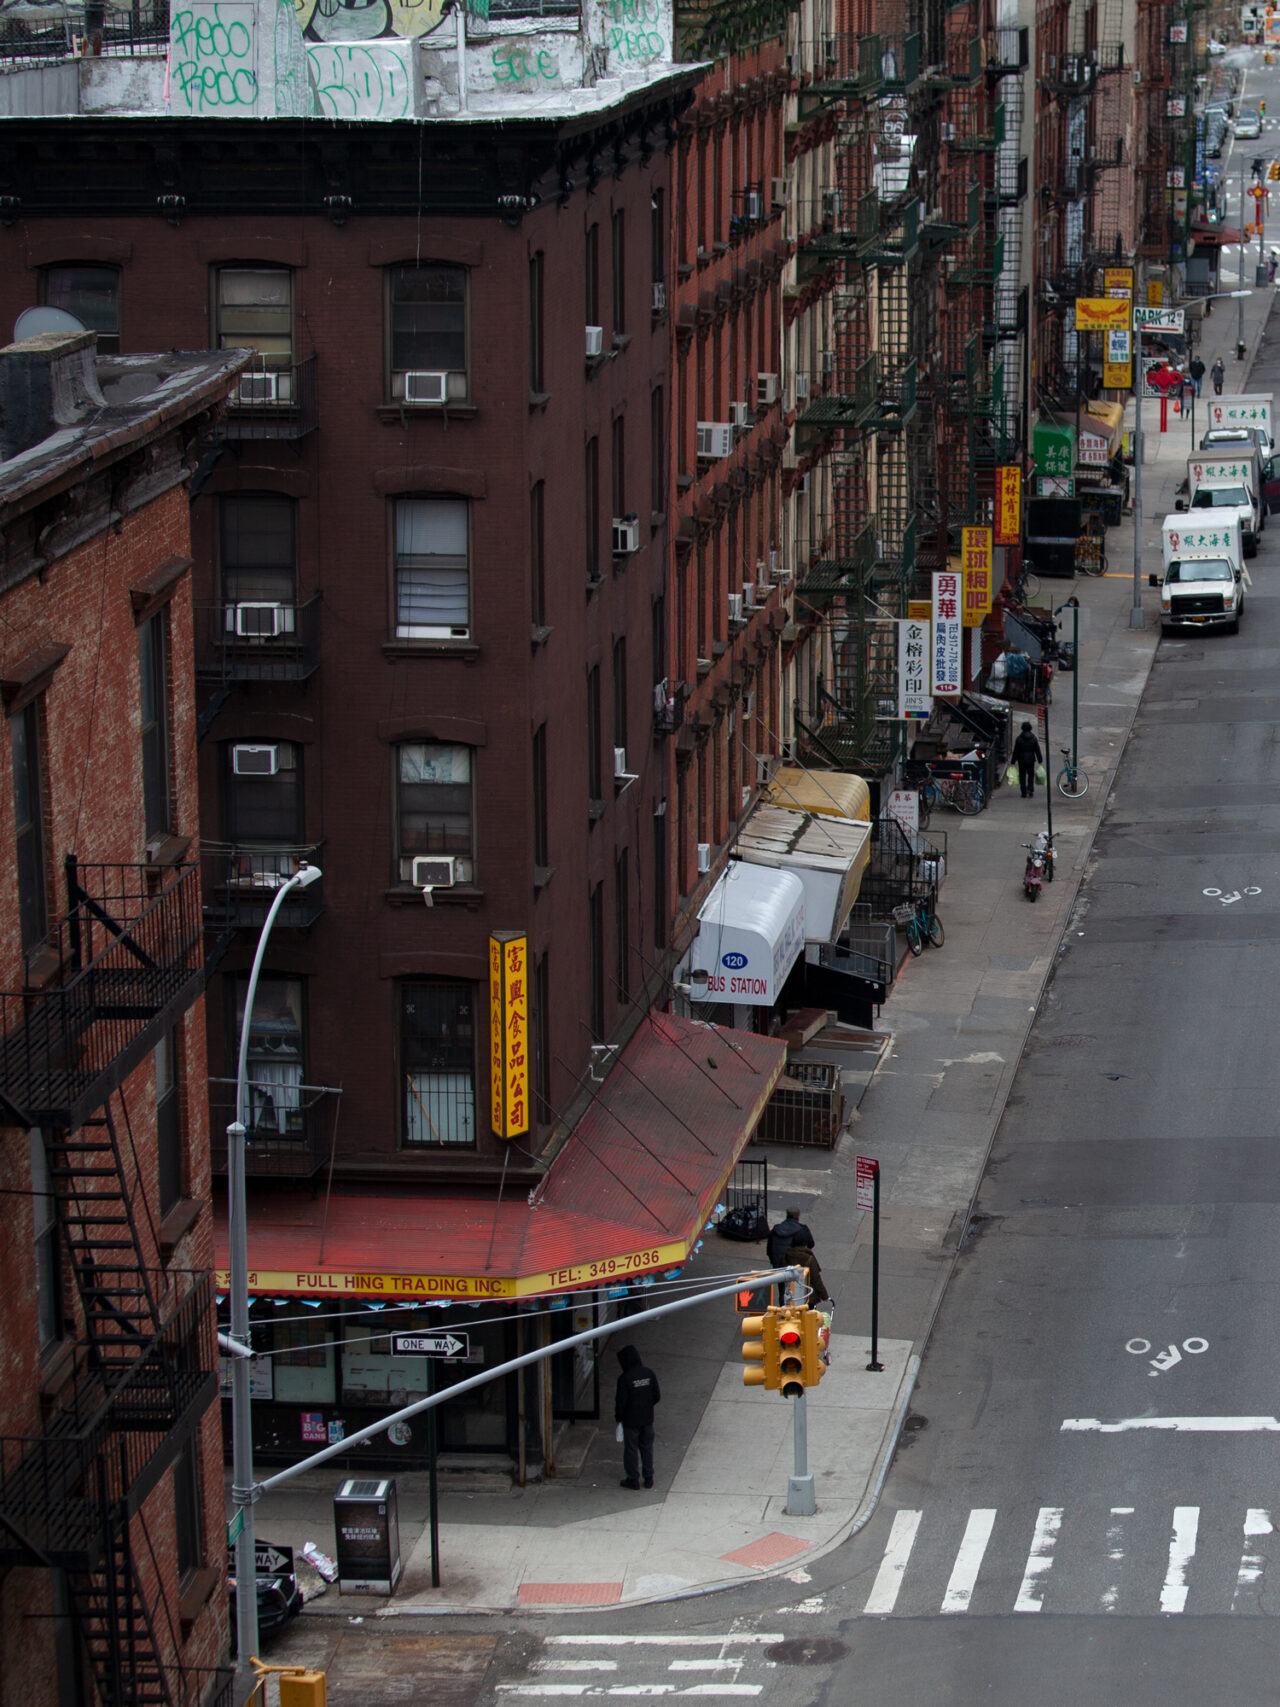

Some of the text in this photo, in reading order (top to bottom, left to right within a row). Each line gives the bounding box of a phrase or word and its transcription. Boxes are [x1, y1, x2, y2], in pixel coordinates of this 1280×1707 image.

[966, 530, 988, 610] 環球網吧
[725, 955, 743, 967] 120
[707, 975, 767, 995] BUS STATION
[507, 946, 525, 1129] 富興食品公司
[296, 1274, 506, 1294] FULL HING TRADING INC.
[548, 1270, 582, 1287] TEL:
[402, 1339, 457, 1351] ONE WAY
